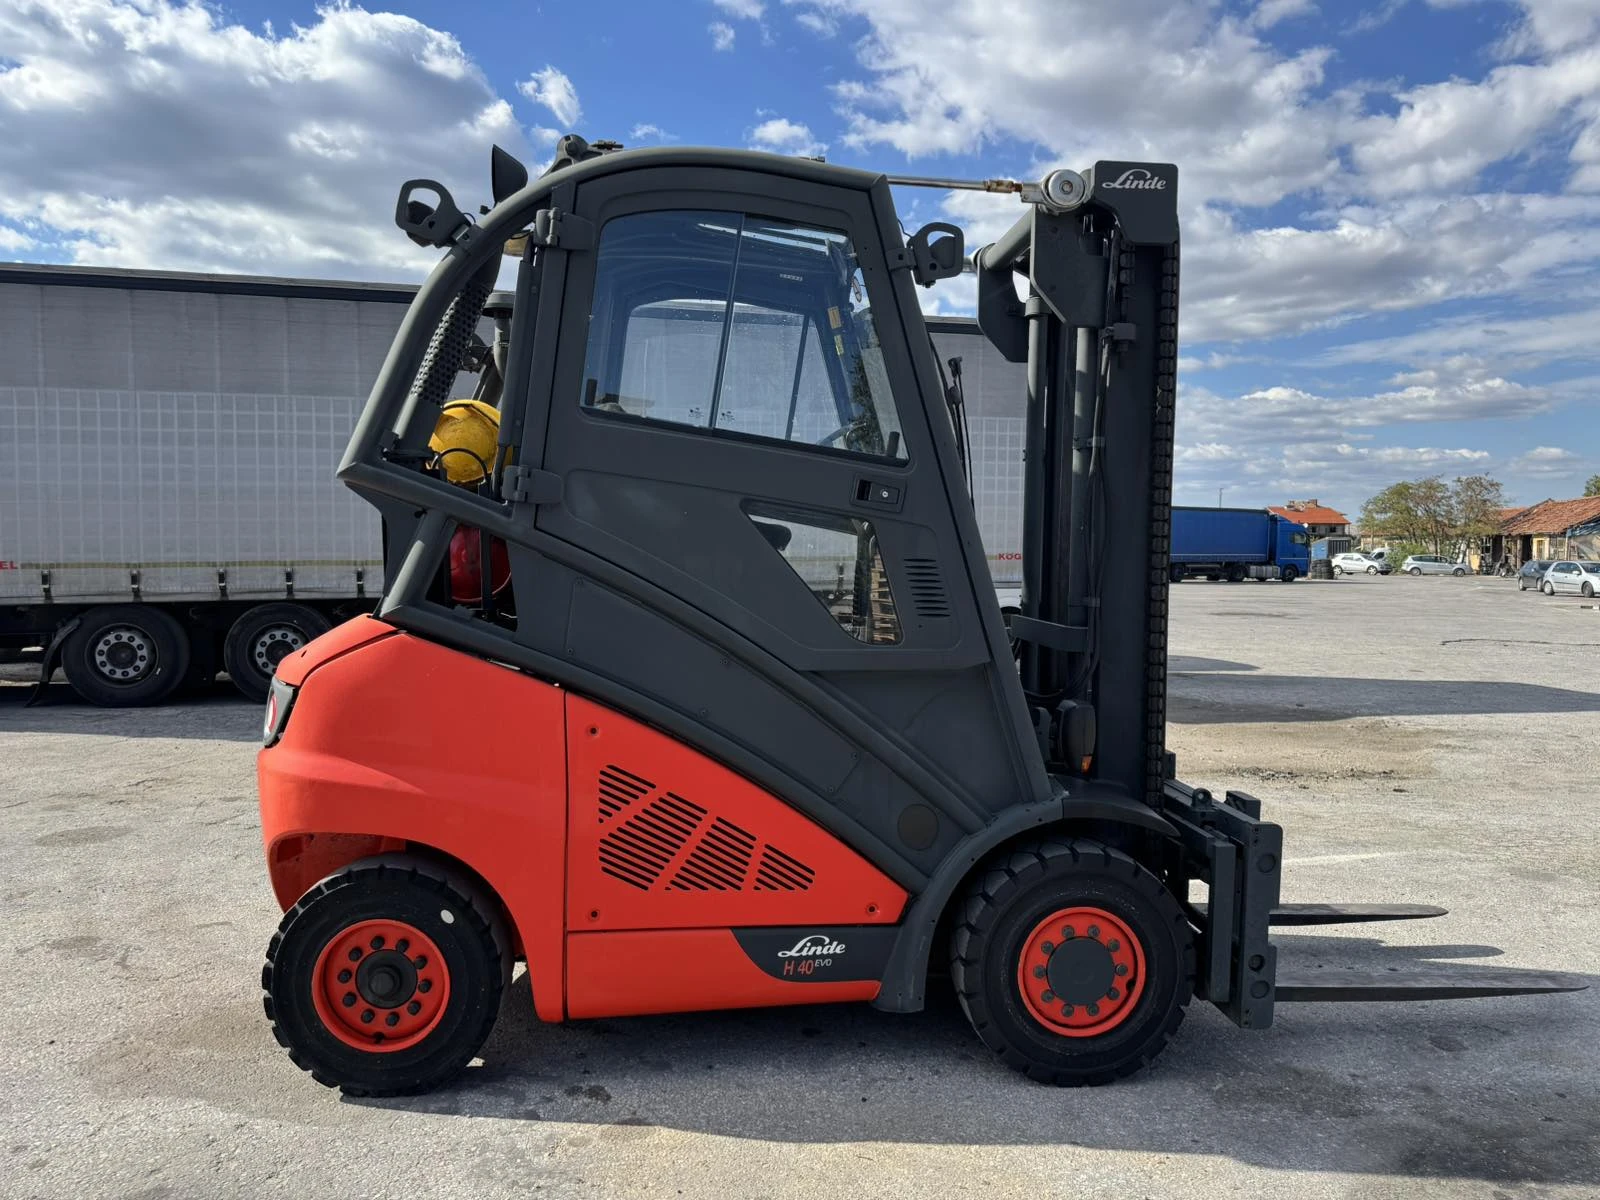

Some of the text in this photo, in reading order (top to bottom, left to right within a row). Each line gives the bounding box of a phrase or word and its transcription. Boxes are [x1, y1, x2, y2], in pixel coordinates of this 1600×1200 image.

[1102, 168, 1167, 190] Linde
[777, 935, 846, 957] Linde
[783, 960, 796, 976] H
